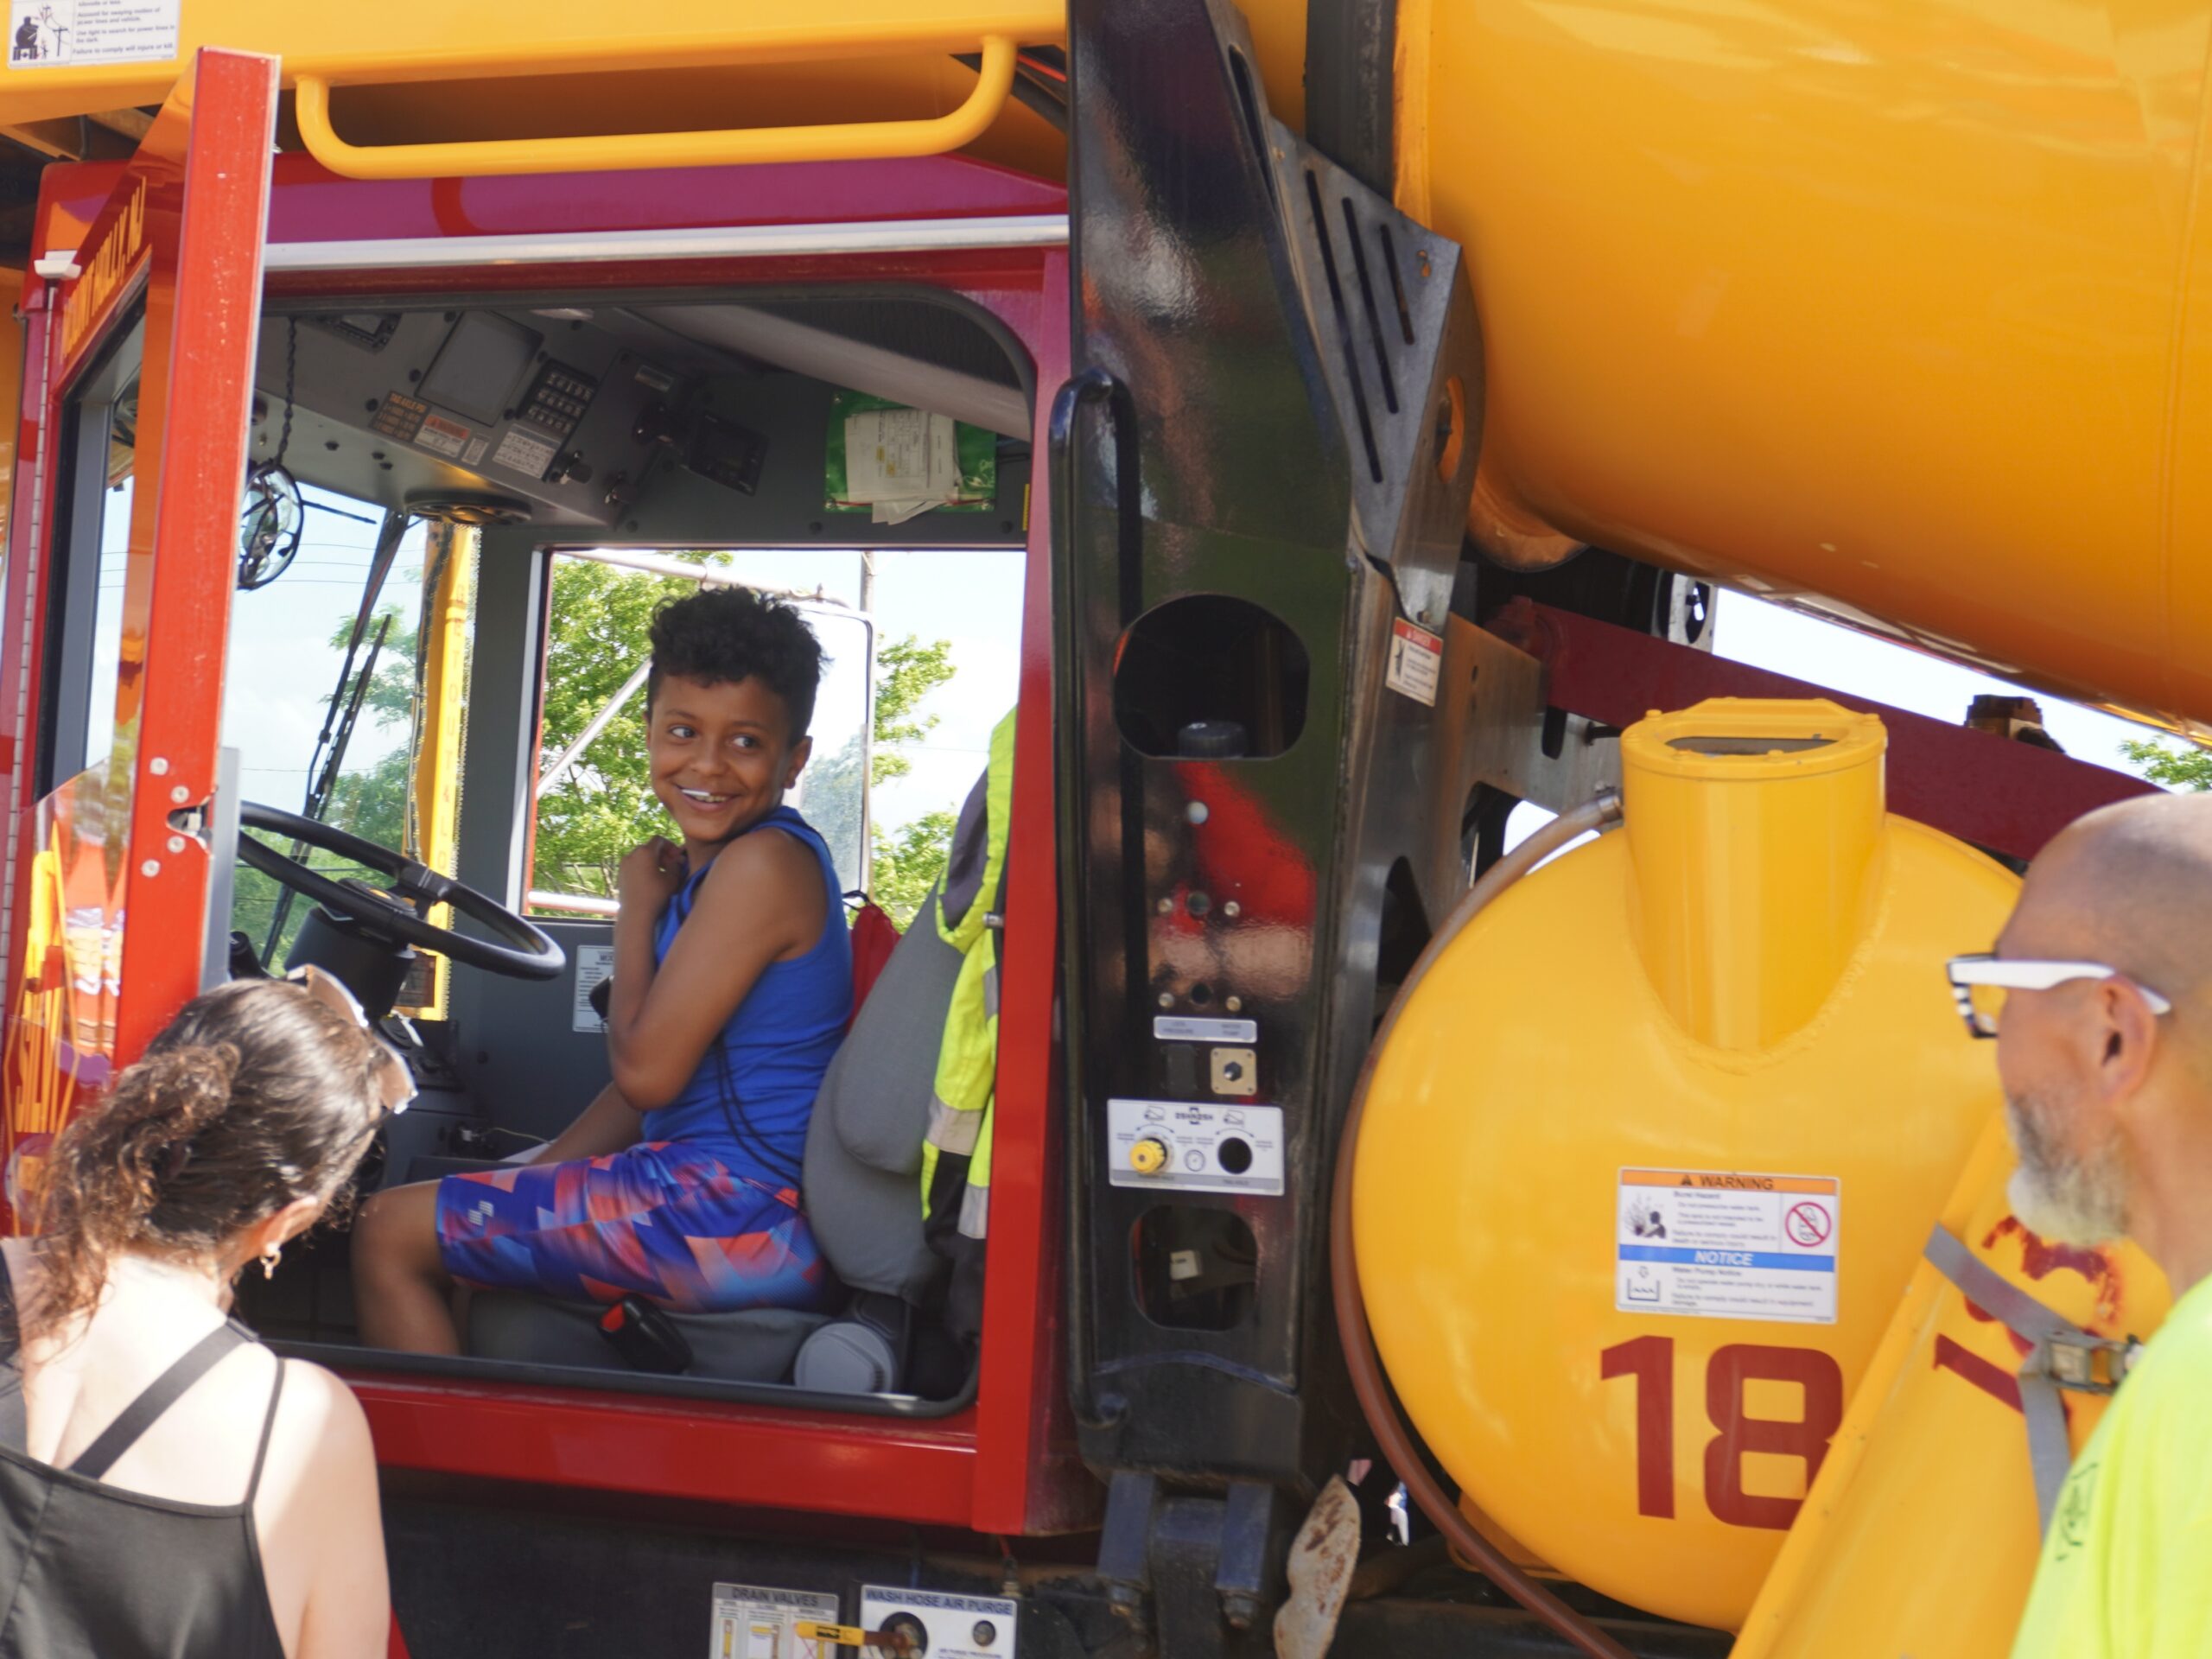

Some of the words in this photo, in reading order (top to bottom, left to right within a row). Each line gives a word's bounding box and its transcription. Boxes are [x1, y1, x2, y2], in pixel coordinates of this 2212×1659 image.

[1700, 1174, 1774, 1191] WARNING
[1694, 1250, 1754, 1266] NOTICE
[1601, 1335, 1842, 1531] 18
[731, 1587, 769, 1602] DRAIN
[772, 1592, 819, 1607] VALVES
[866, 1589, 902, 1603] WASH
[906, 1593, 940, 1607] HOSE
[944, 1598, 963, 1611] AIR
[968, 1602, 1013, 1615] PURGE
